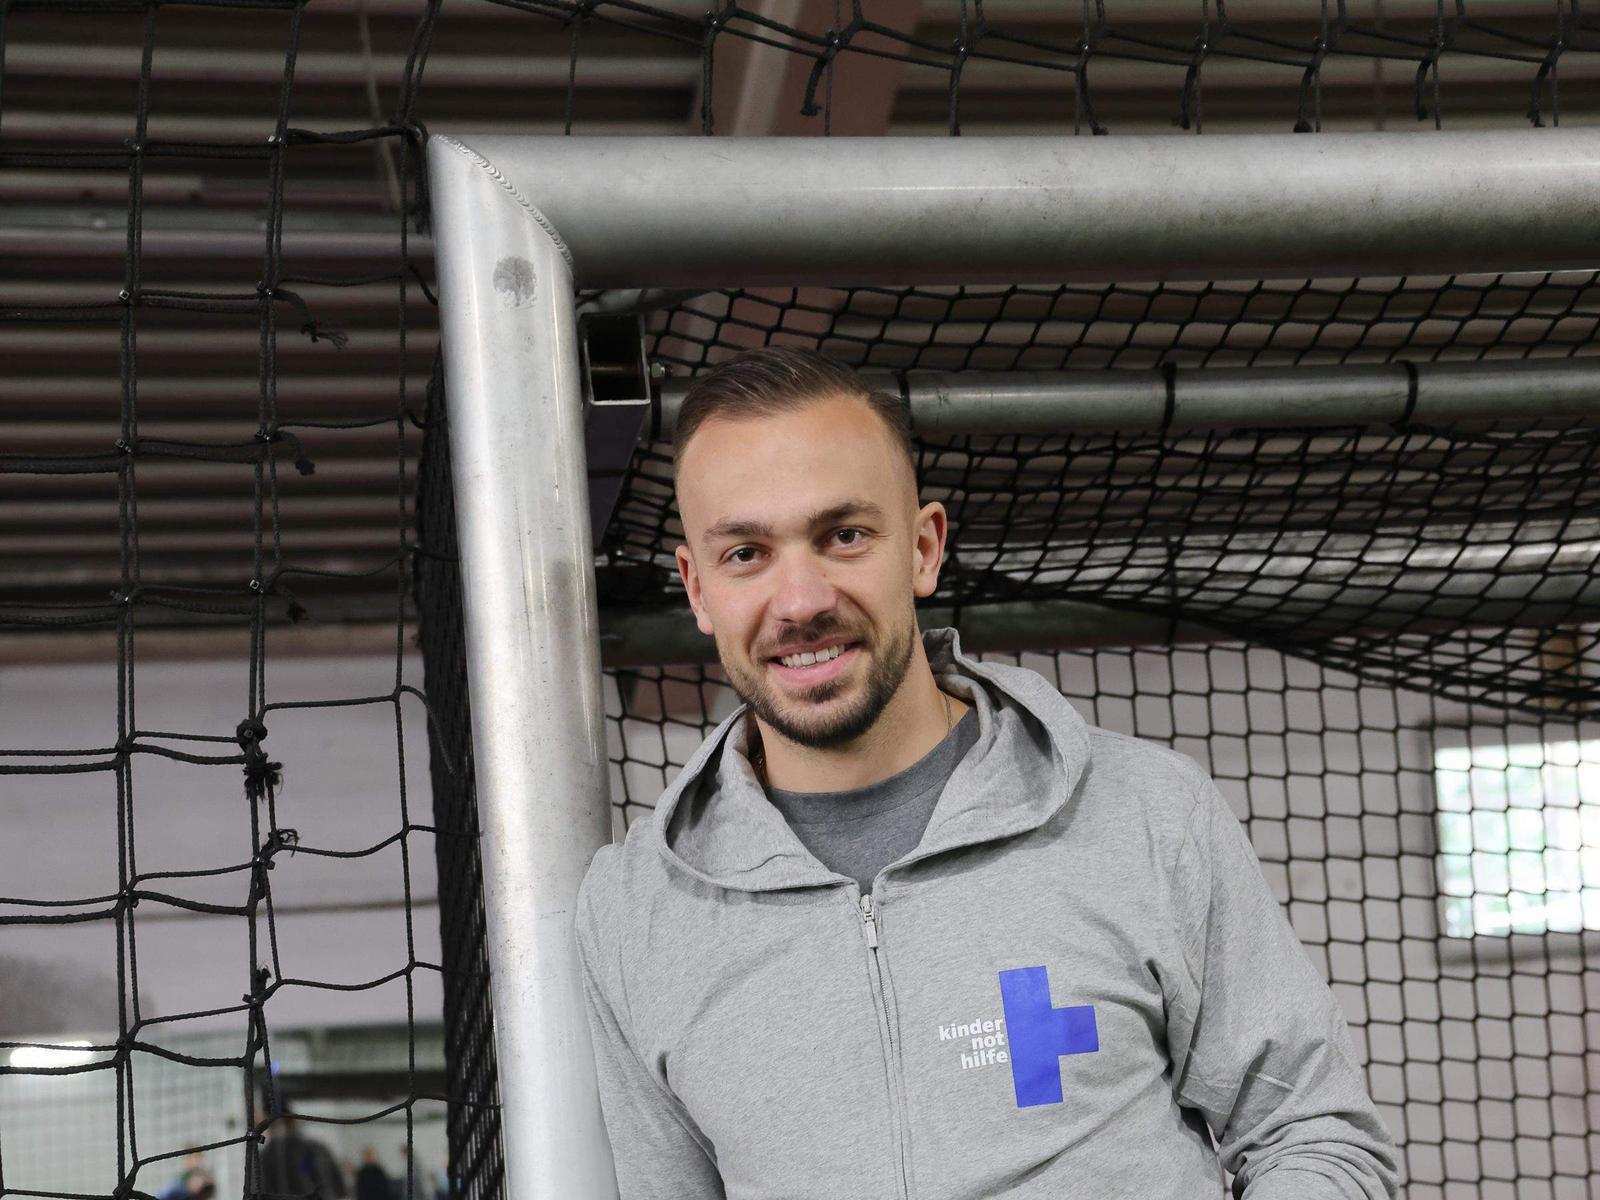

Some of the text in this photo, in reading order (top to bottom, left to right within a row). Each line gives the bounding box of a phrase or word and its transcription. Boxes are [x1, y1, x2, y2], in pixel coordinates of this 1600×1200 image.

[938, 1018, 1004, 1041] kinder
[971, 1031, 1005, 1050] not
[960, 1049, 1008, 1070] hilfe
